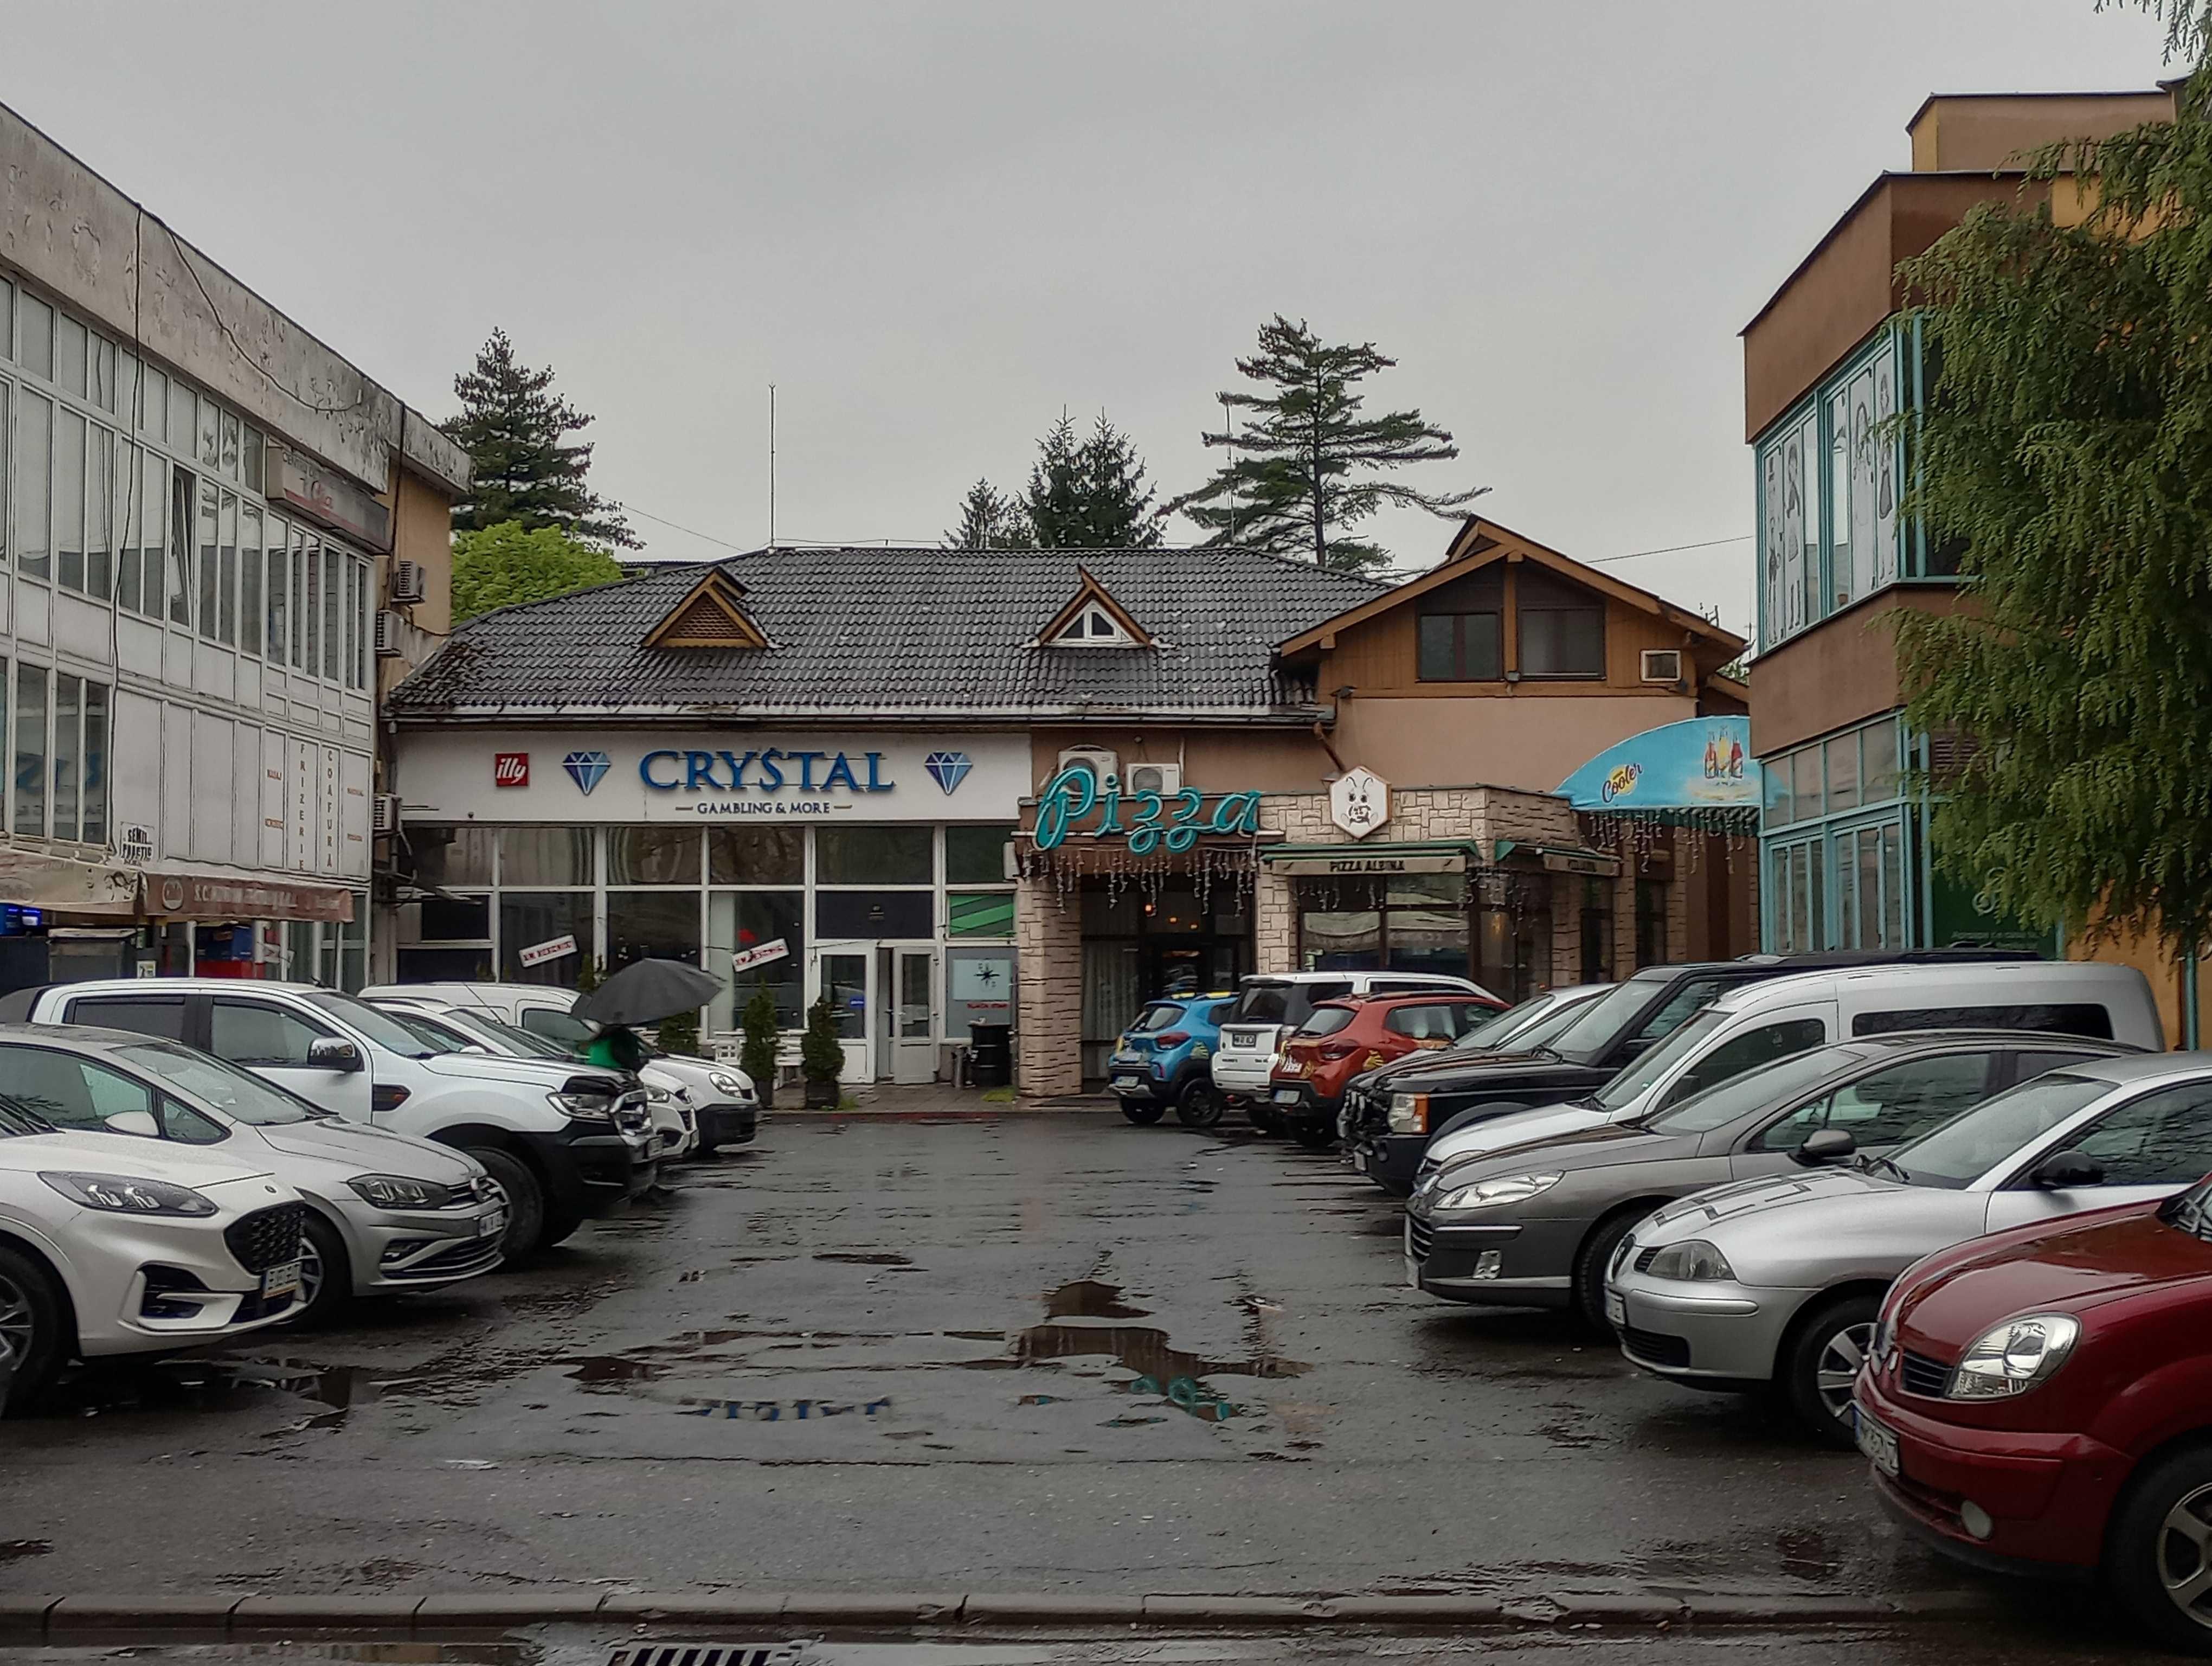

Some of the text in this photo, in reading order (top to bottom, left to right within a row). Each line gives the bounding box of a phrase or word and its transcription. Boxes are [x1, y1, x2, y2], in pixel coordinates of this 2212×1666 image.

[496, 758, 526, 784] illy
[1602, 762, 1643, 803] Cooler
[697, 802, 830, 814] GAMBLING & MORE
[1032, 766, 1261, 855] Pizza
[1329, 860, 1362, 873] PIZZA
